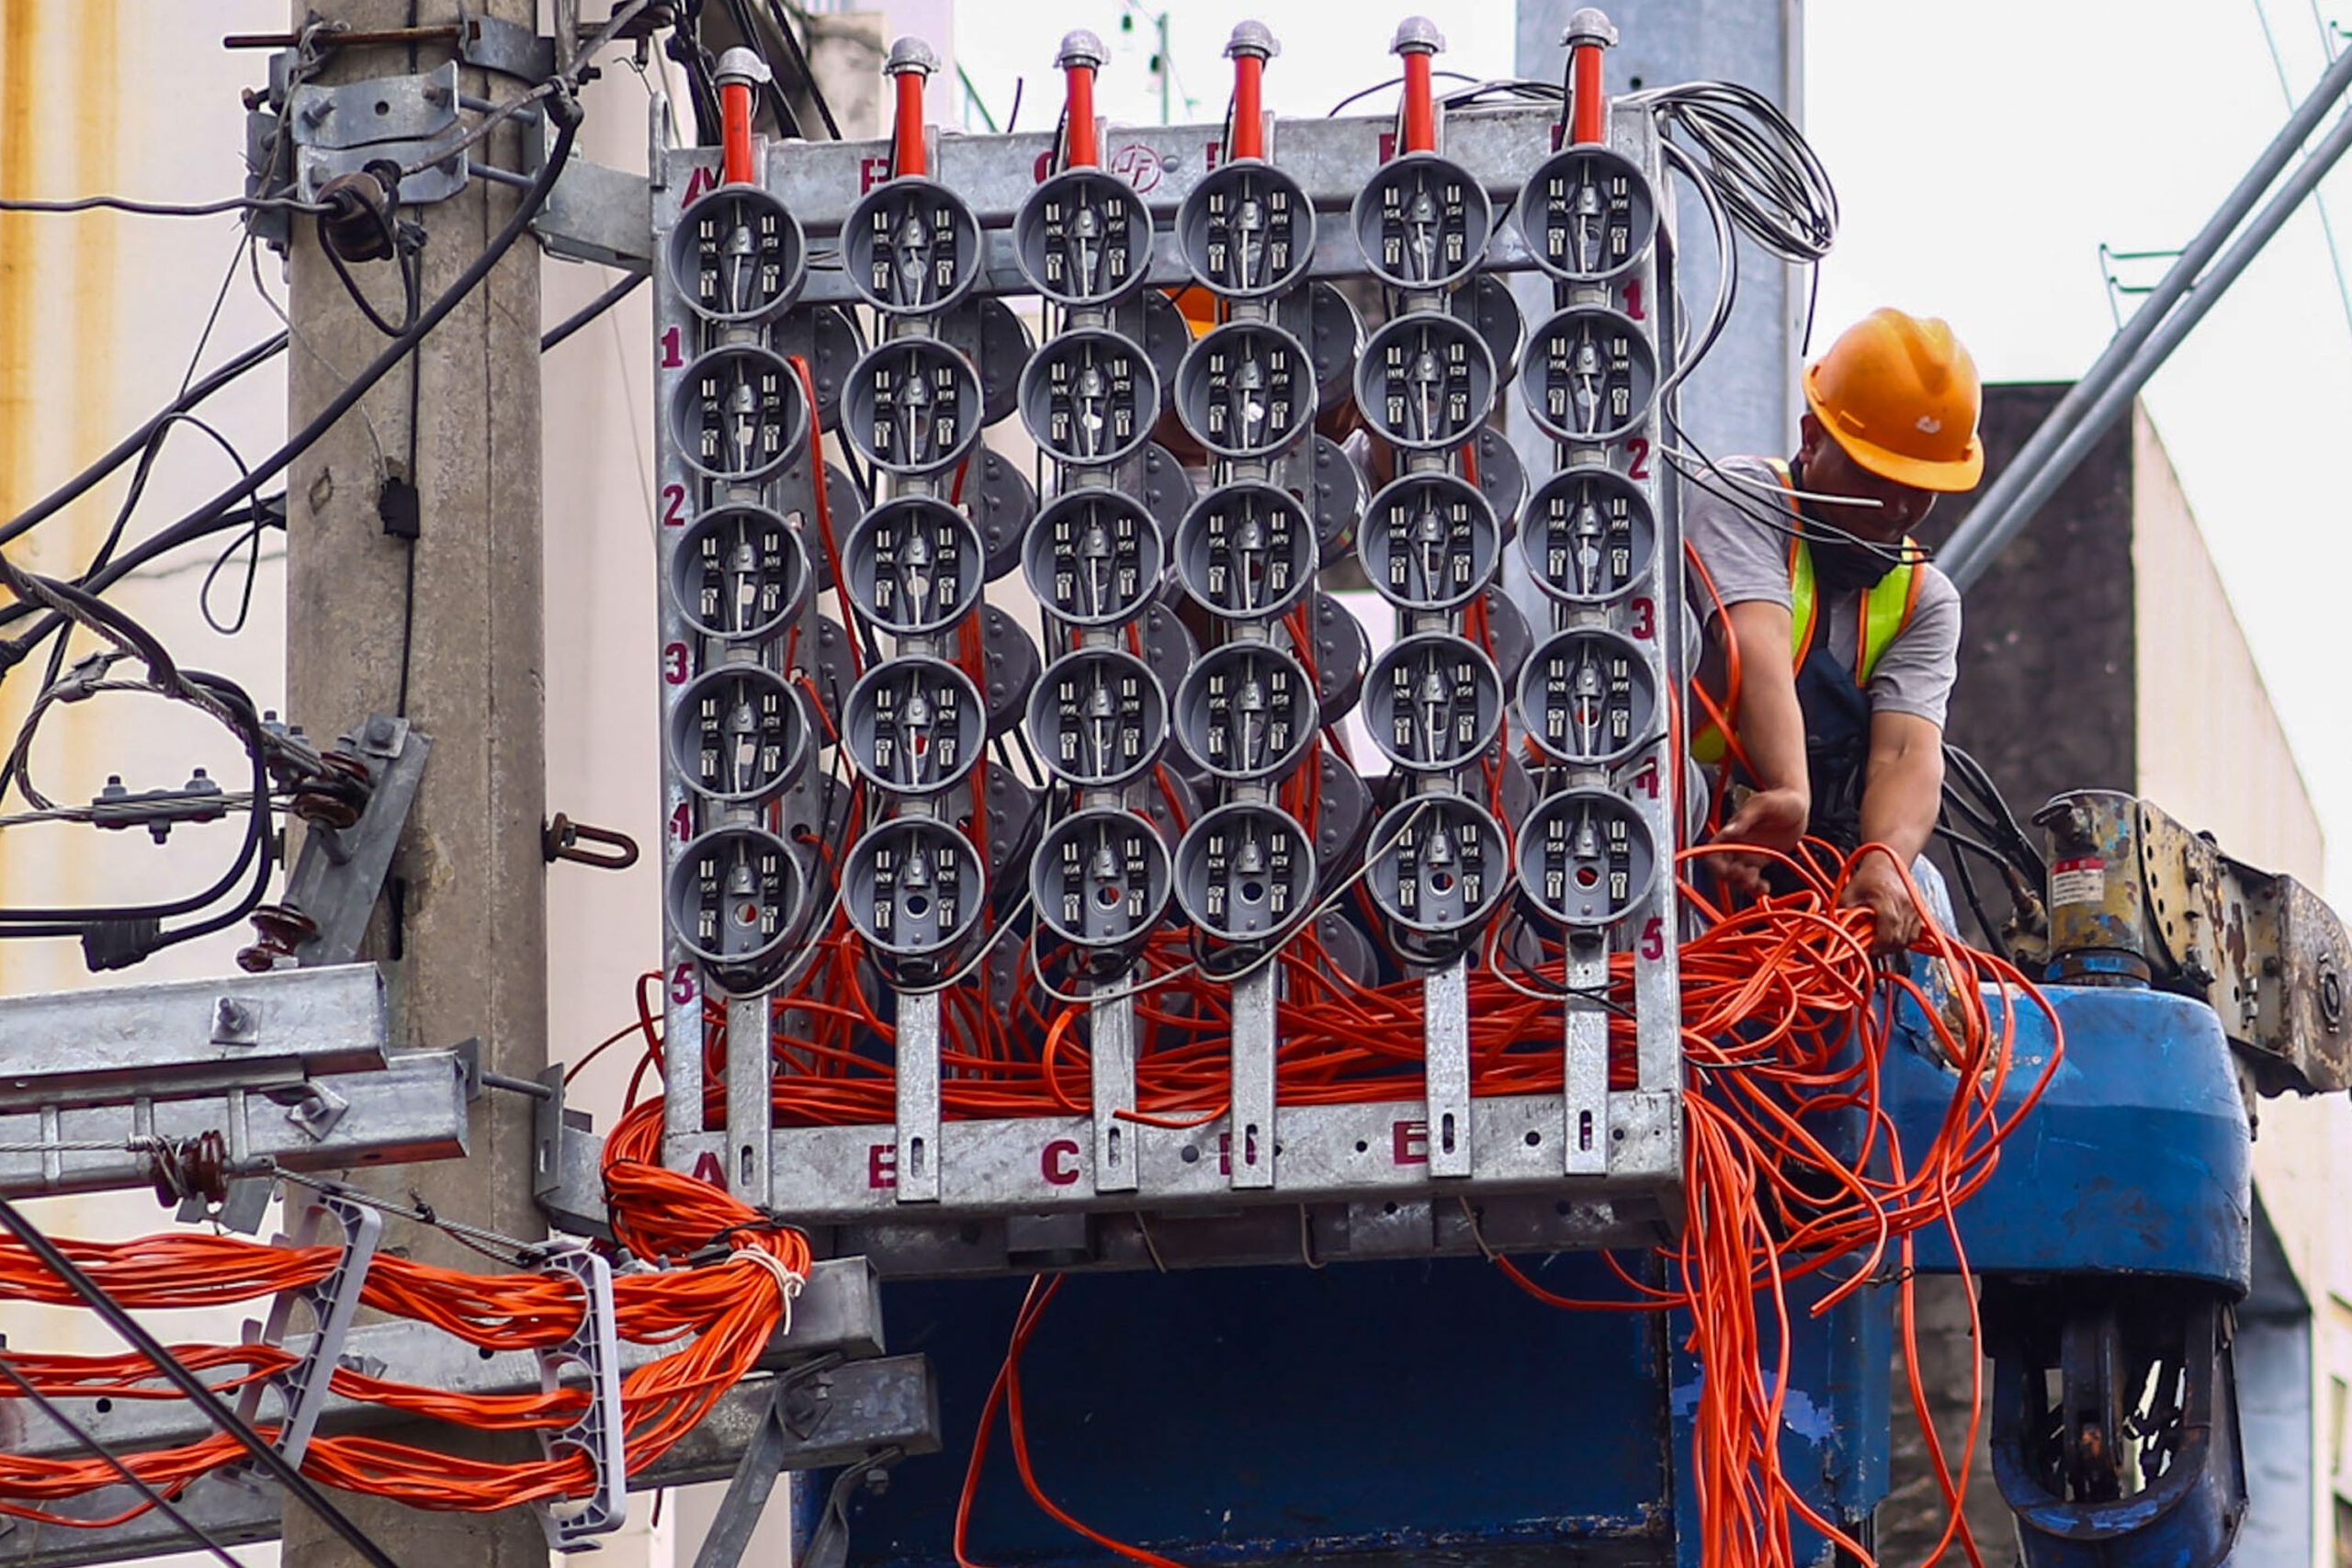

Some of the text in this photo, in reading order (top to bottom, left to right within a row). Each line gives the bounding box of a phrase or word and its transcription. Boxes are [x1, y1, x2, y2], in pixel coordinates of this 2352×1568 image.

[1623, 279, 1645, 321] 1
[662, 327, 684, 368] 1
[1626, 437, 1650, 480] 2
[662, 484, 685, 527] 2
[1631, 597, 1656, 640] 3
[665, 642, 688, 685] 3
[1641, 916, 1665, 961] 5
[671, 963, 695, 1005] 5
[692, 1151, 729, 1195] A
[1040, 1139, 1080, 1186] C
